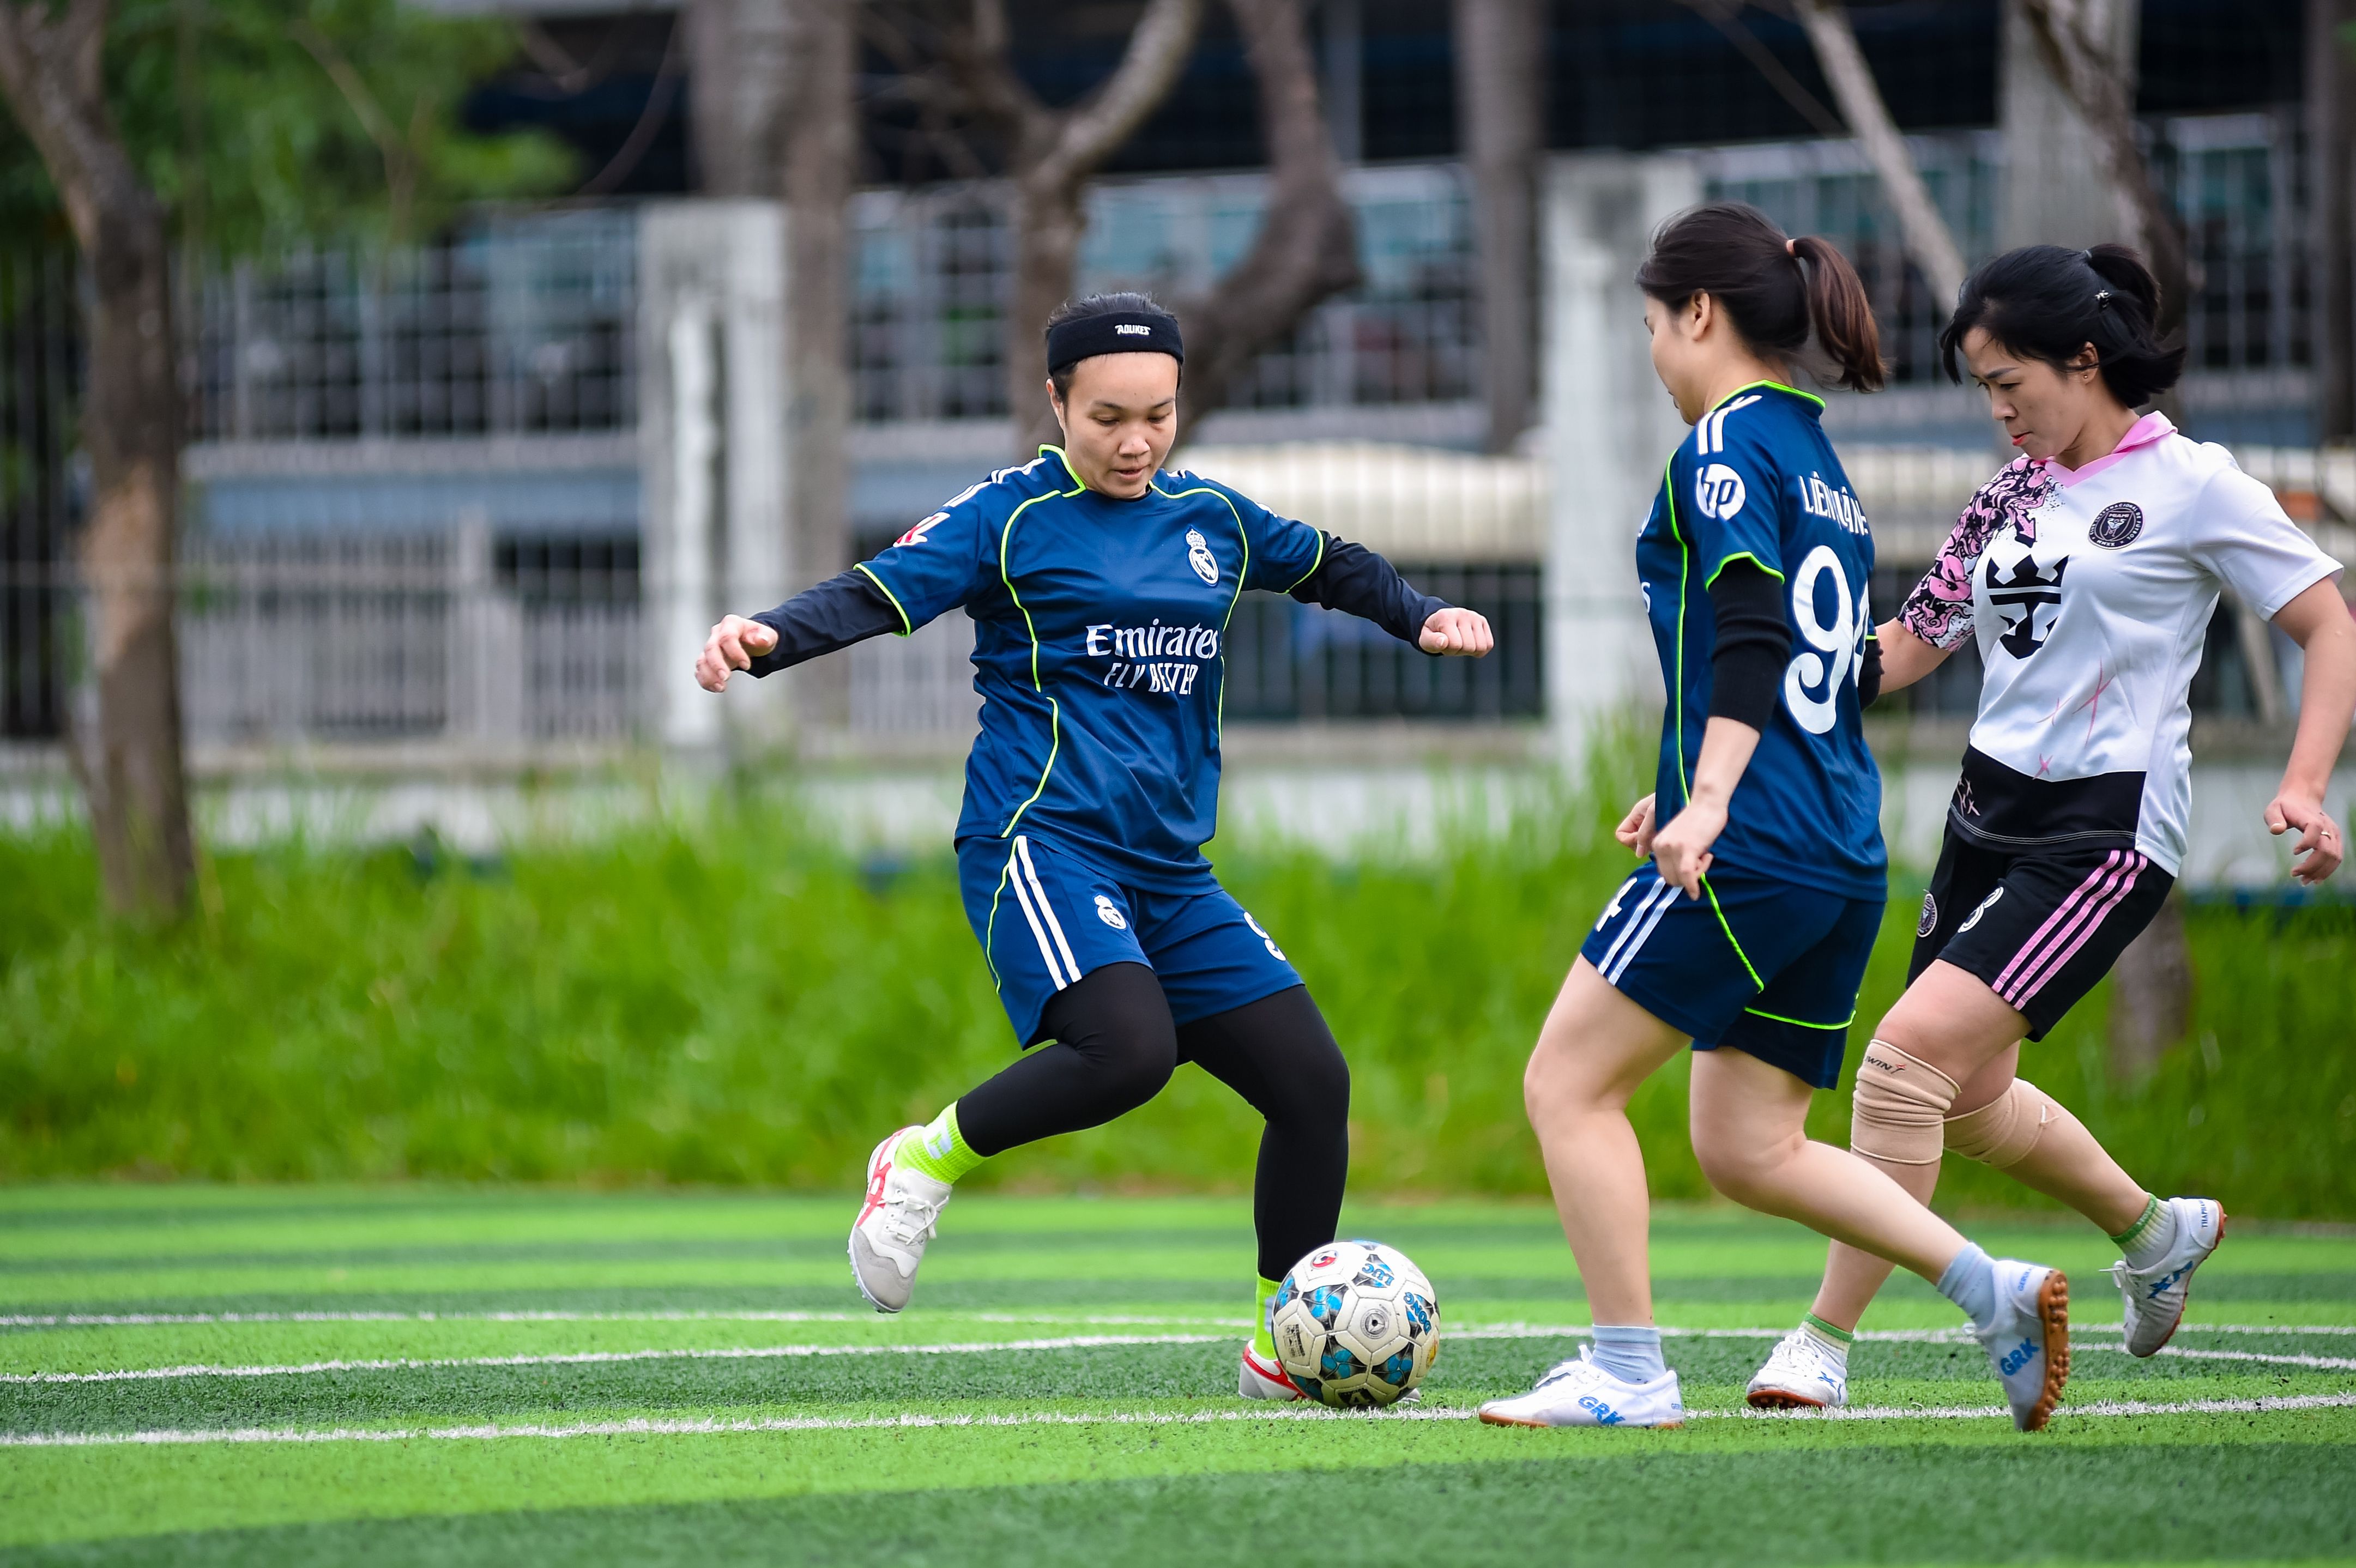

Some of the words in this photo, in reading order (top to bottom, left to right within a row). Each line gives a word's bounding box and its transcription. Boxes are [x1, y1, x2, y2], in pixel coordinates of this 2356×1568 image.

[1799, 471, 1836, 520] LIÊN
[1085, 618, 1217, 659] Emirates
[1104, 662, 1146, 689] FLY
[2000, 1337, 2040, 1376] GRK
[1578, 1396, 1626, 1424] GRK
